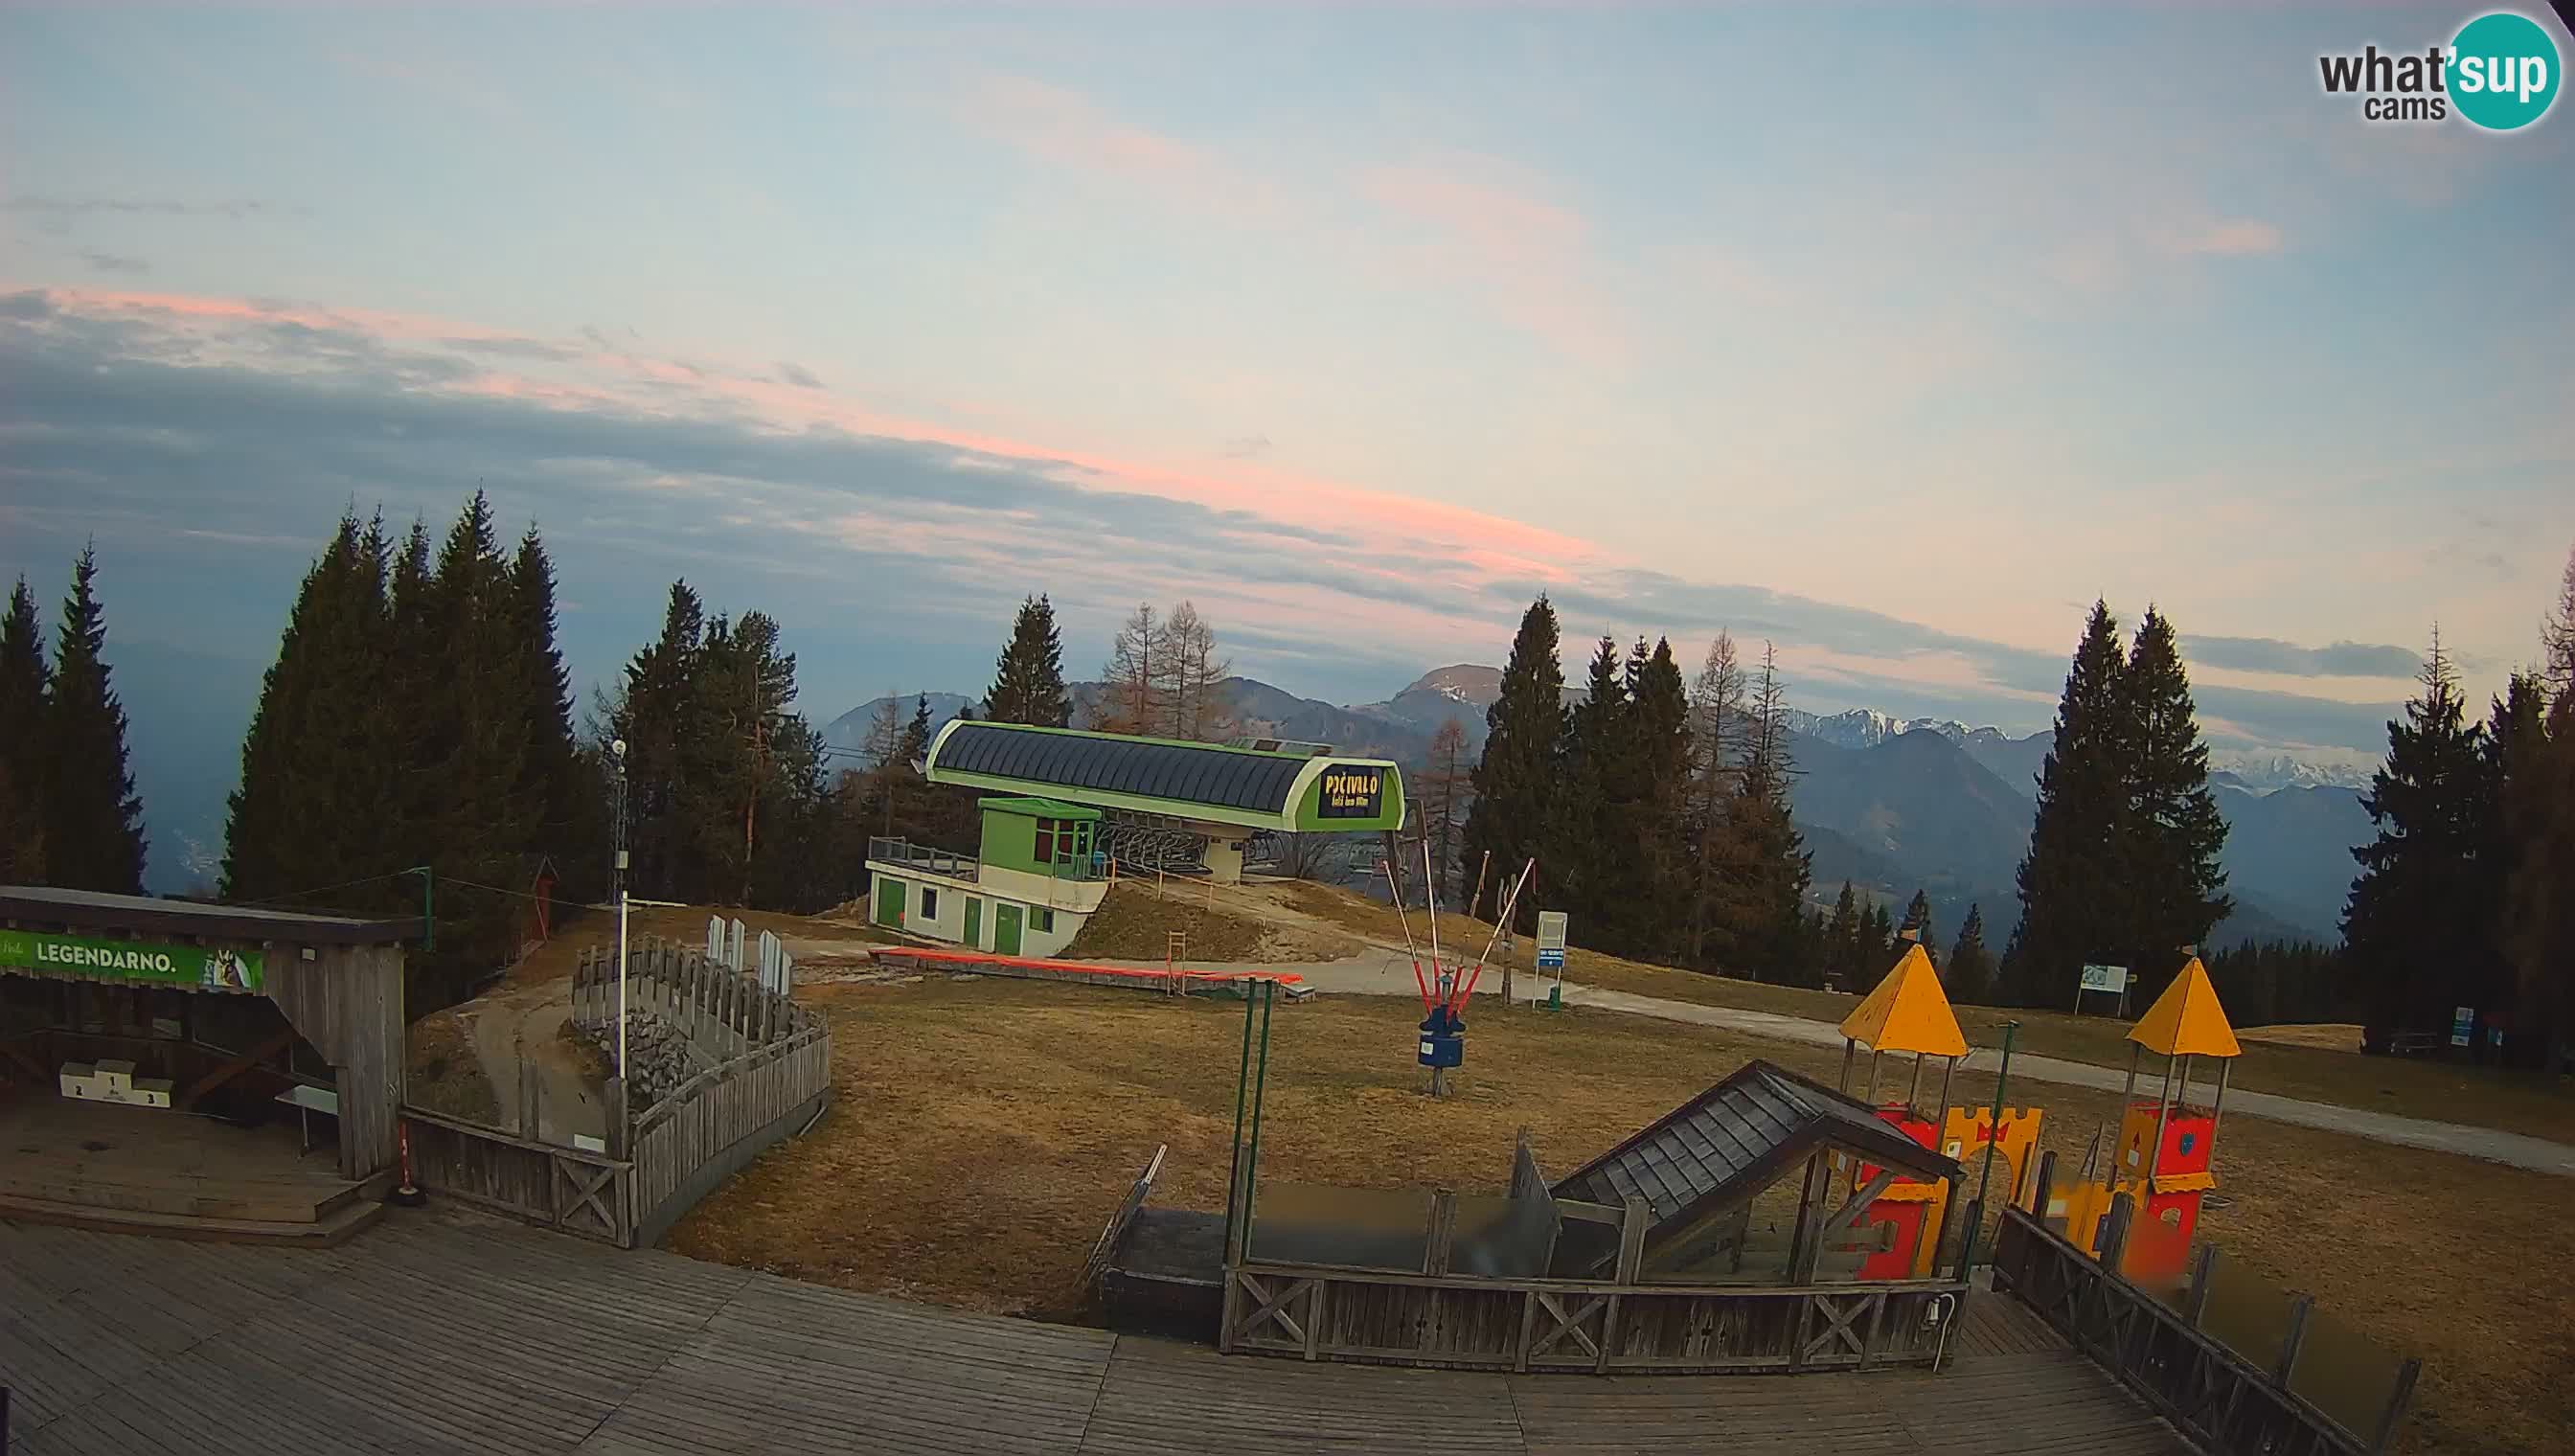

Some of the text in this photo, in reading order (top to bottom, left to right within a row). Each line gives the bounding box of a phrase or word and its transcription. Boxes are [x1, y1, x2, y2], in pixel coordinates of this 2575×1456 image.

[36, 942, 176, 973] LEGENDARNO.
[109, 1076, 116, 1086] 1
[75, 1085, 83, 1096] 2
[147, 1093, 155, 1104] 3
